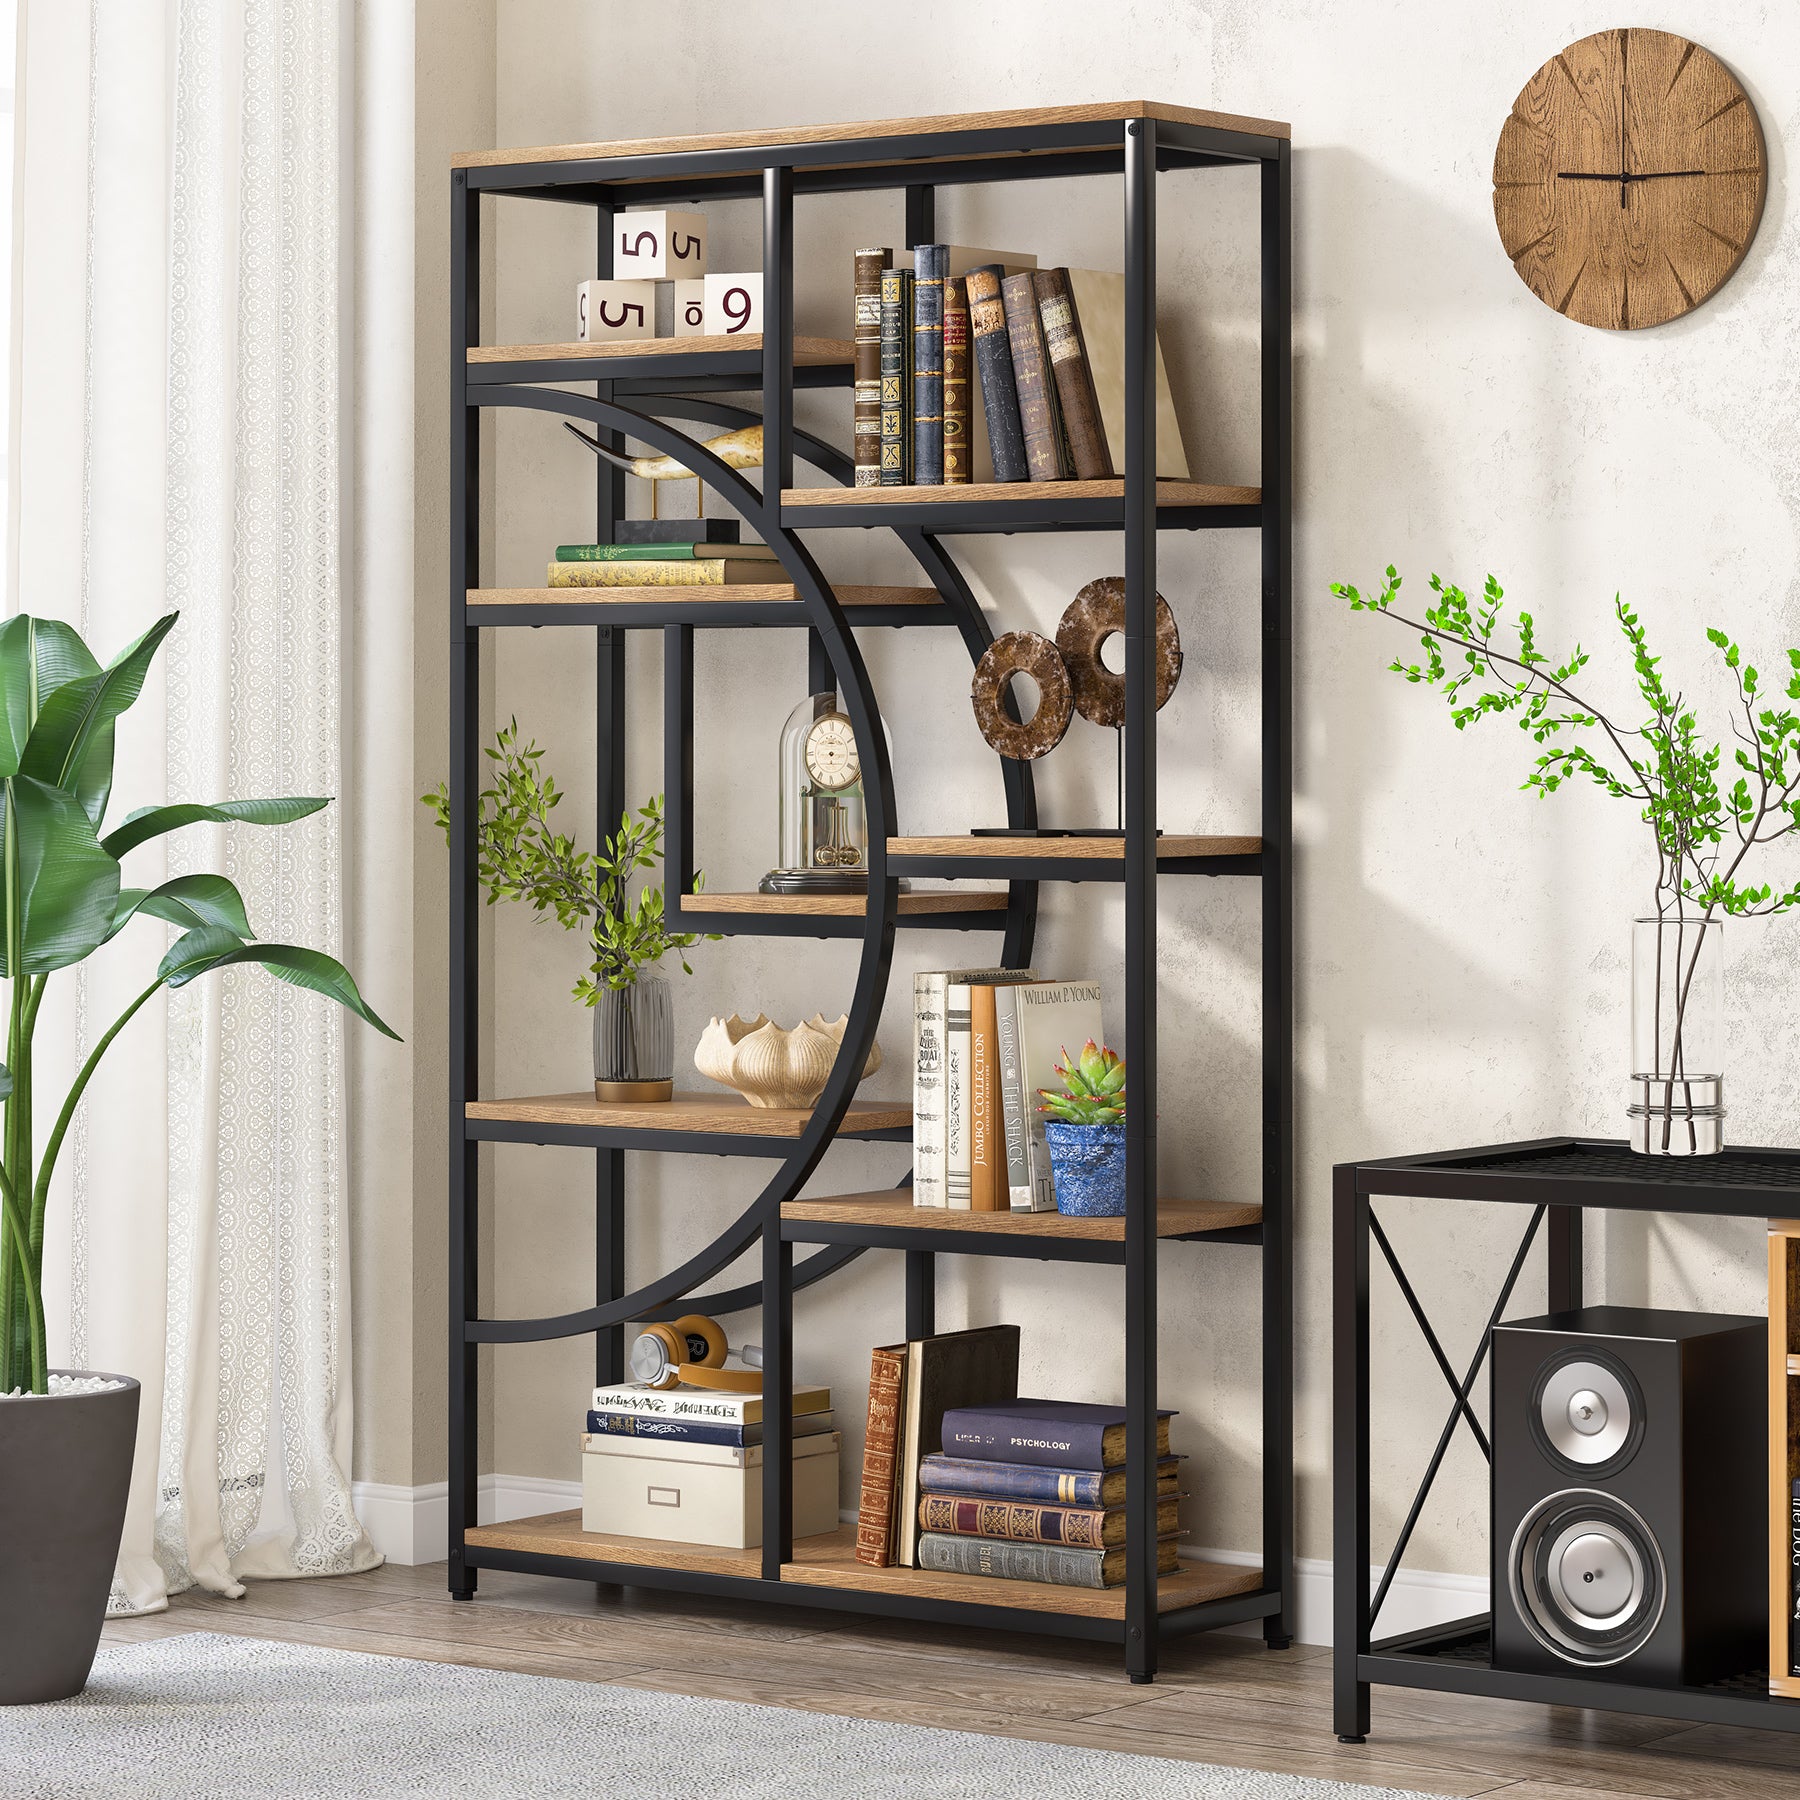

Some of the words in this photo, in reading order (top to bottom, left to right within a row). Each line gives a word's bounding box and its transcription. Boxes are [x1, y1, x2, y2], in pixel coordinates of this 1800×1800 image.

[622, 230, 658, 258] 5
[672, 231, 701, 261] 5
[599, 300, 644, 328] 5
[1024, 989, 1062, 1005] WILLIAM
[1063, 987, 1070, 1003] P.
[1070, 986, 1101, 1002] YOUNG
[1000, 1012, 1016, 1068] YOUNG
[973, 1033, 985, 1117] COLLECTION
[1004, 1082, 1019, 1113] THE
[974, 1120, 987, 1166] JUMBO
[1006, 1117, 1023, 1168] SHACK
[1010, 1437, 1071, 1450] PSYCHOLOGY
